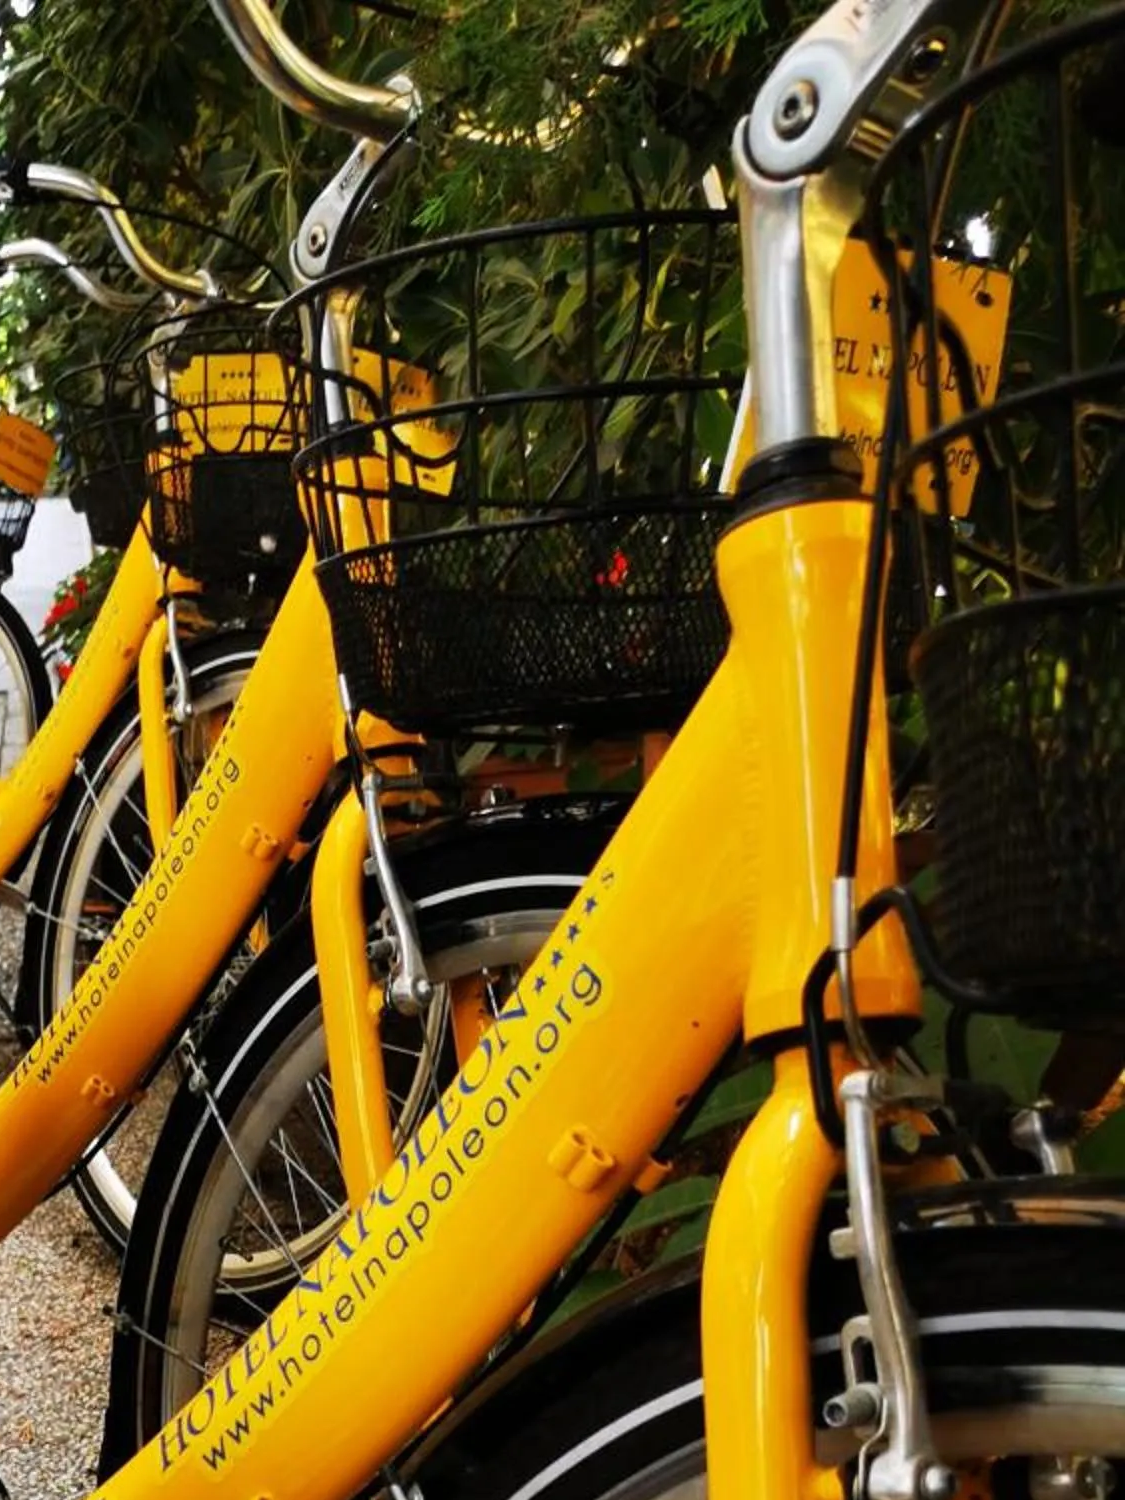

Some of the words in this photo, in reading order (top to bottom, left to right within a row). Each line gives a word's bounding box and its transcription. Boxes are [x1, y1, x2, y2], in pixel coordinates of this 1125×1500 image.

[37, 757, 241, 1084] www.hotelnapoleon.org
[159, 1316, 288, 1472] HOTEL
[296, 990, 528, 1318] NAPOLEON
[201, 962, 604, 1472] www.hotelnapoleon.org
